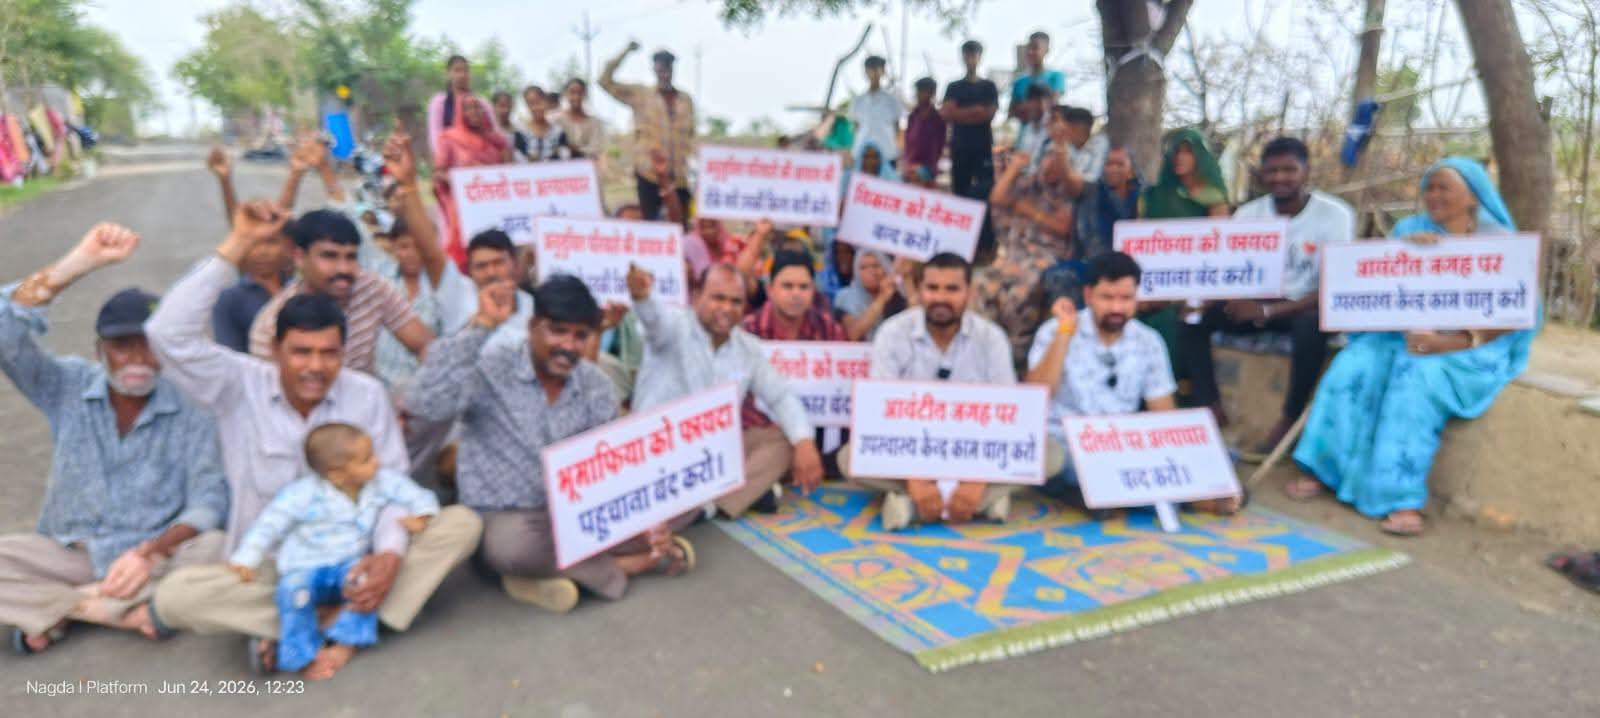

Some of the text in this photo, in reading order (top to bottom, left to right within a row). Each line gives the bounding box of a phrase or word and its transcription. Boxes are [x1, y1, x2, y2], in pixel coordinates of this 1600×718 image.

[905, 196, 925, 220] को
[1122, 229, 1193, 256] भमाफिया
[1199, 227, 1226, 251] को
[1478, 254, 1504, 273] पर
[1141, 268, 1192, 293] हुचाना
[812, 352, 832, 379] को
[995, 402, 1019, 425] पर
[1124, 429, 1145, 450] पर
[557, 440, 646, 503] भूमाफिया
[650, 415, 675, 456] को
